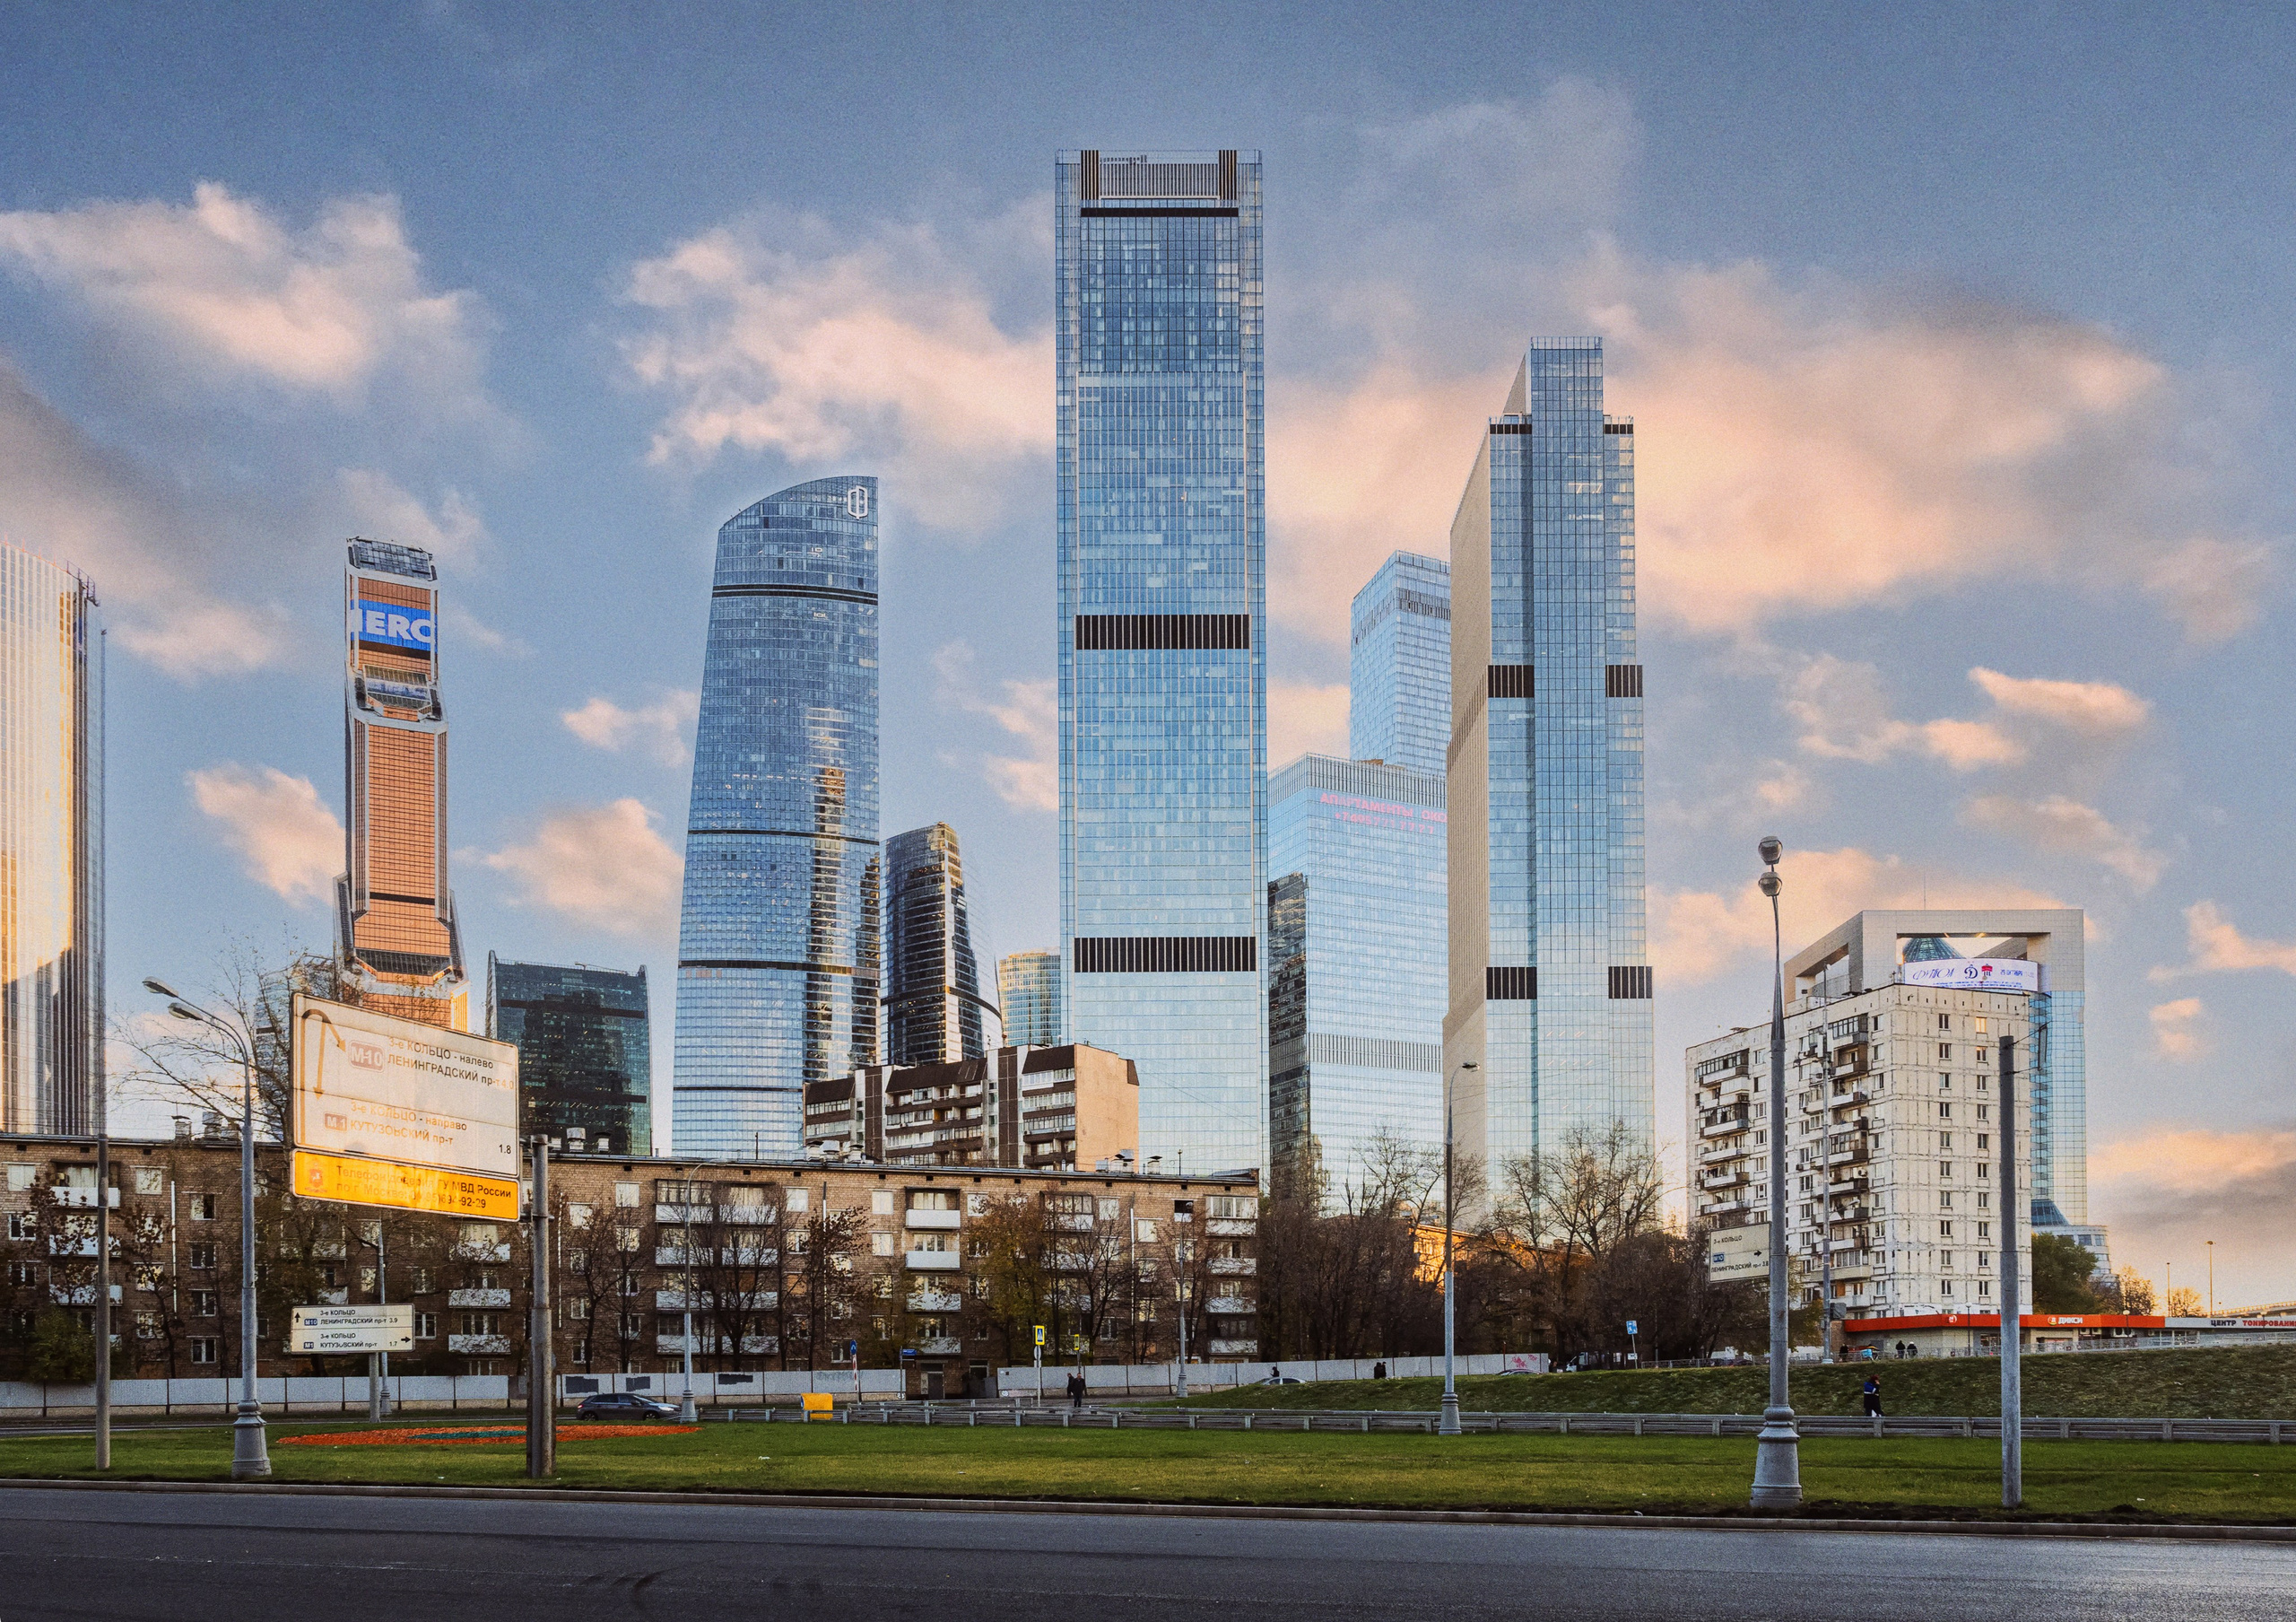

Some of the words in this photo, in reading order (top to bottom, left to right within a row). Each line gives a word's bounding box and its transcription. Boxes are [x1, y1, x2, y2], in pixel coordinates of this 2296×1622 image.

[1320, 792, 1413, 817] АПАРТАМЕНТЫ
[1422, 809, 1448, 823] ОКО
[388, 1037, 404, 1050] 3-е
[407, 1042, 451, 1060] КОЛЬЦО
[459, 1055, 493, 1068] налево
[387, 1053, 478, 1082] ЛЕНИНГРАДСКИЙ
[481, 1076, 500, 1086] пр-т
[501, 1080, 514, 1090] 4.0
[351, 1101, 367, 1113] 3-е
[370, 1104, 416, 1122] КОЛЬЦО
[426, 1117, 467, 1131] направо
[350, 1120, 430, 1141] КУТУЗОВСКИЙ
[432, 1134, 453, 1146] пр-т
[499, 1144, 511, 1155] 1.8
[336, 1165, 387, 1183] Телефон
[452, 1182, 475, 1194] МВД
[477, 1185, 511, 1199] России
[1721, 1235, 1743, 1243] КОЛЬЦО
[1711, 1261, 1752, 1273] ЛЕНИНГРАДСКИЙ
[320, 1317, 373, 1325] ЛЕНИНГРАДСКИЙ
